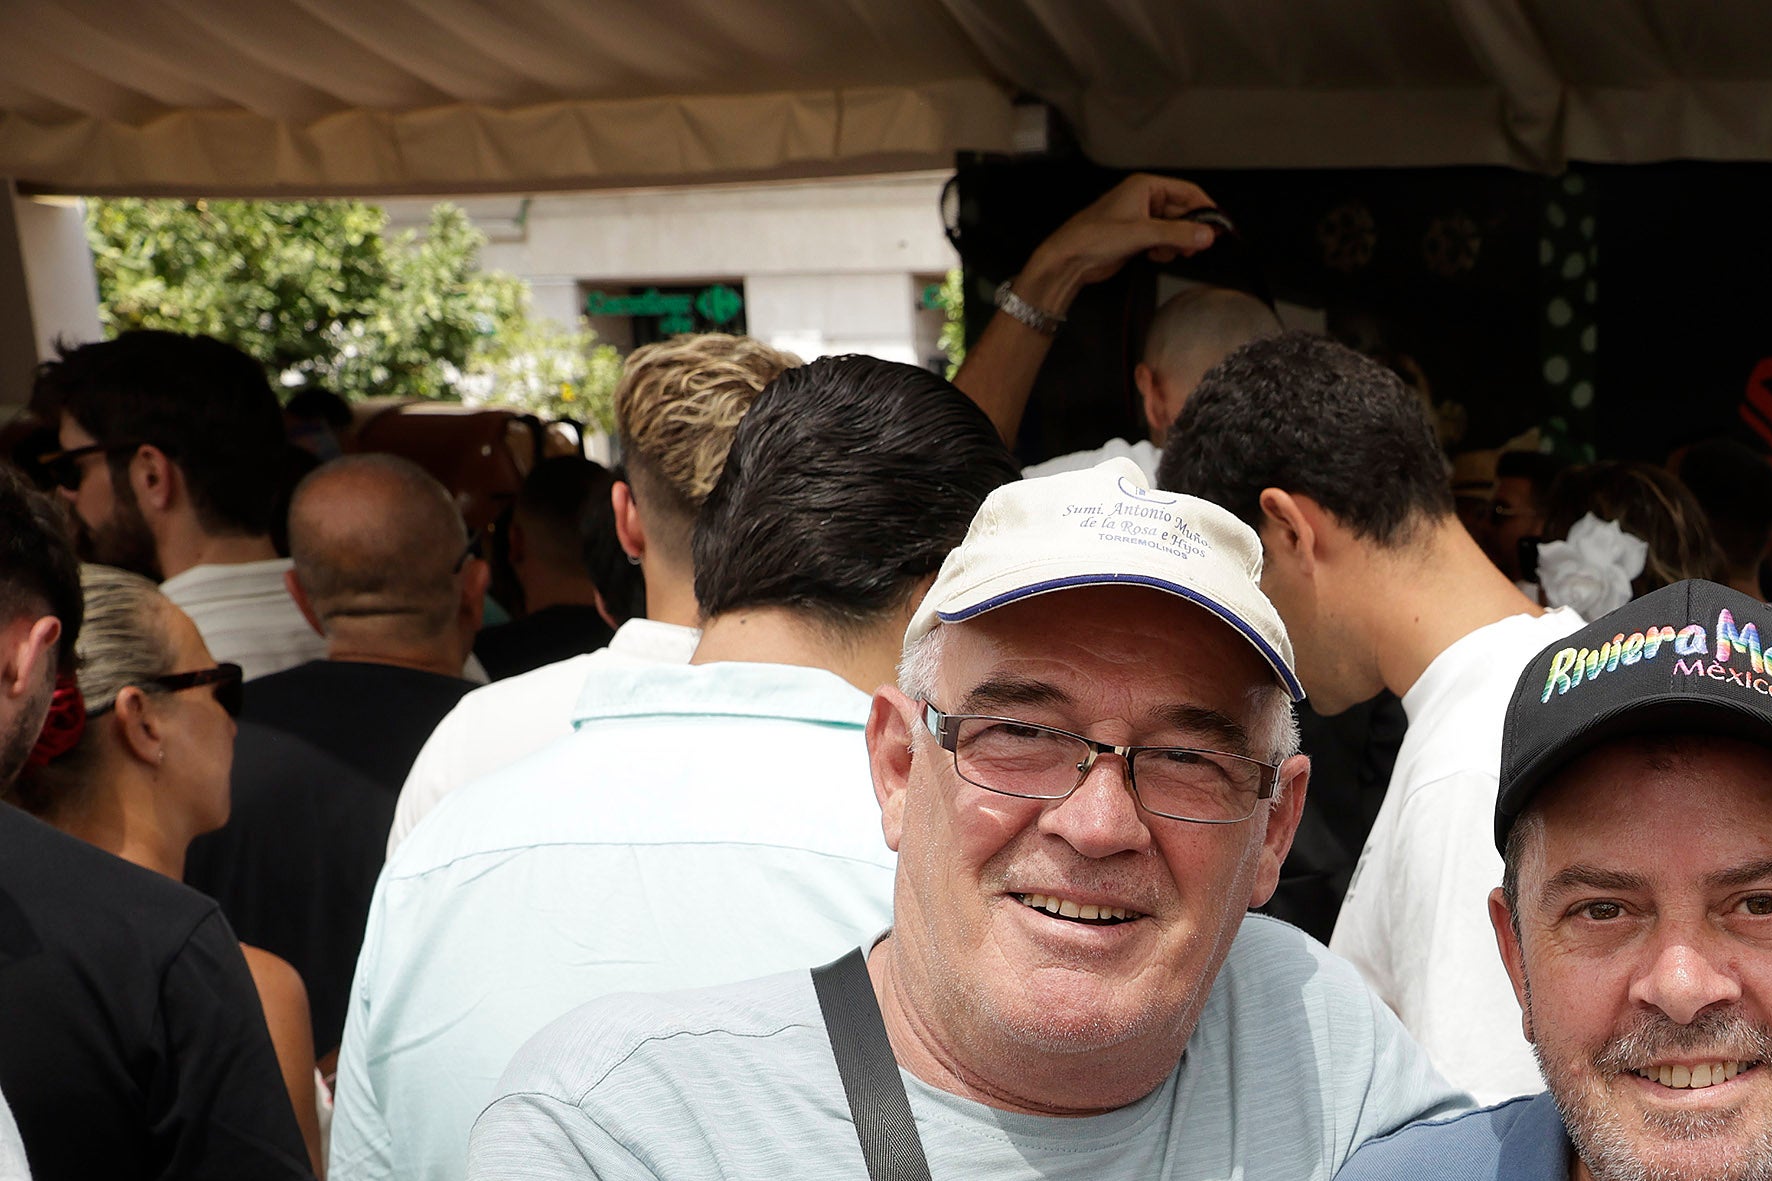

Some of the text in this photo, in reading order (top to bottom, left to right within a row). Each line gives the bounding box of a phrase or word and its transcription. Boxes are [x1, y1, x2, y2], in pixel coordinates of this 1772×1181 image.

[1109, 502, 1172, 522] Antonio
[1079, 516, 1206, 558] de la Rosa e Hijos
[1098, 533, 1188, 560] TORREMOLINOS
[1541, 622, 1708, 703] Riviera
